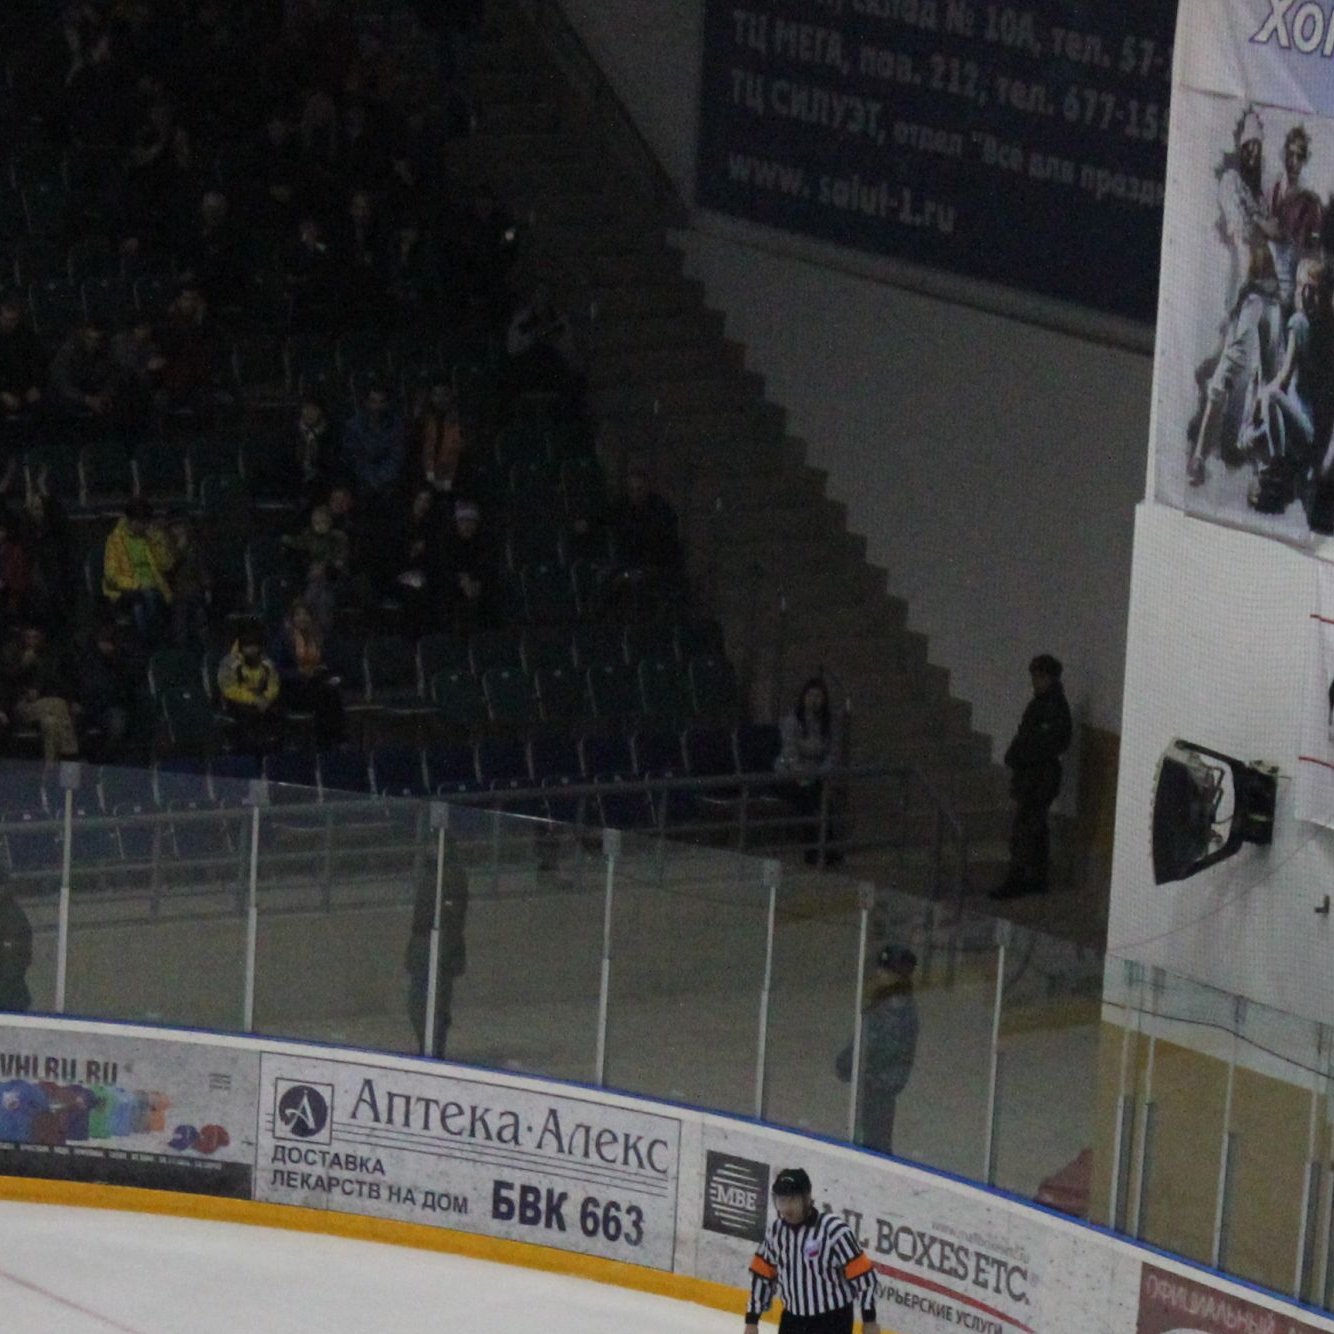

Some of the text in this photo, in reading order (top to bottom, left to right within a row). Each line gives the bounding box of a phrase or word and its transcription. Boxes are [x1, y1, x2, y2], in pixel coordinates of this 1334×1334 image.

[271, 1145, 385, 1176] ДОСТАВКА
[270, 1169, 468, 1216] ЛЕКАРСТВ НА ДОМ
[492, 1180, 645, 1247] БВК 663
[716, 1185, 758, 1211] MBE
[875, 1218, 970, 1282] BOXES
